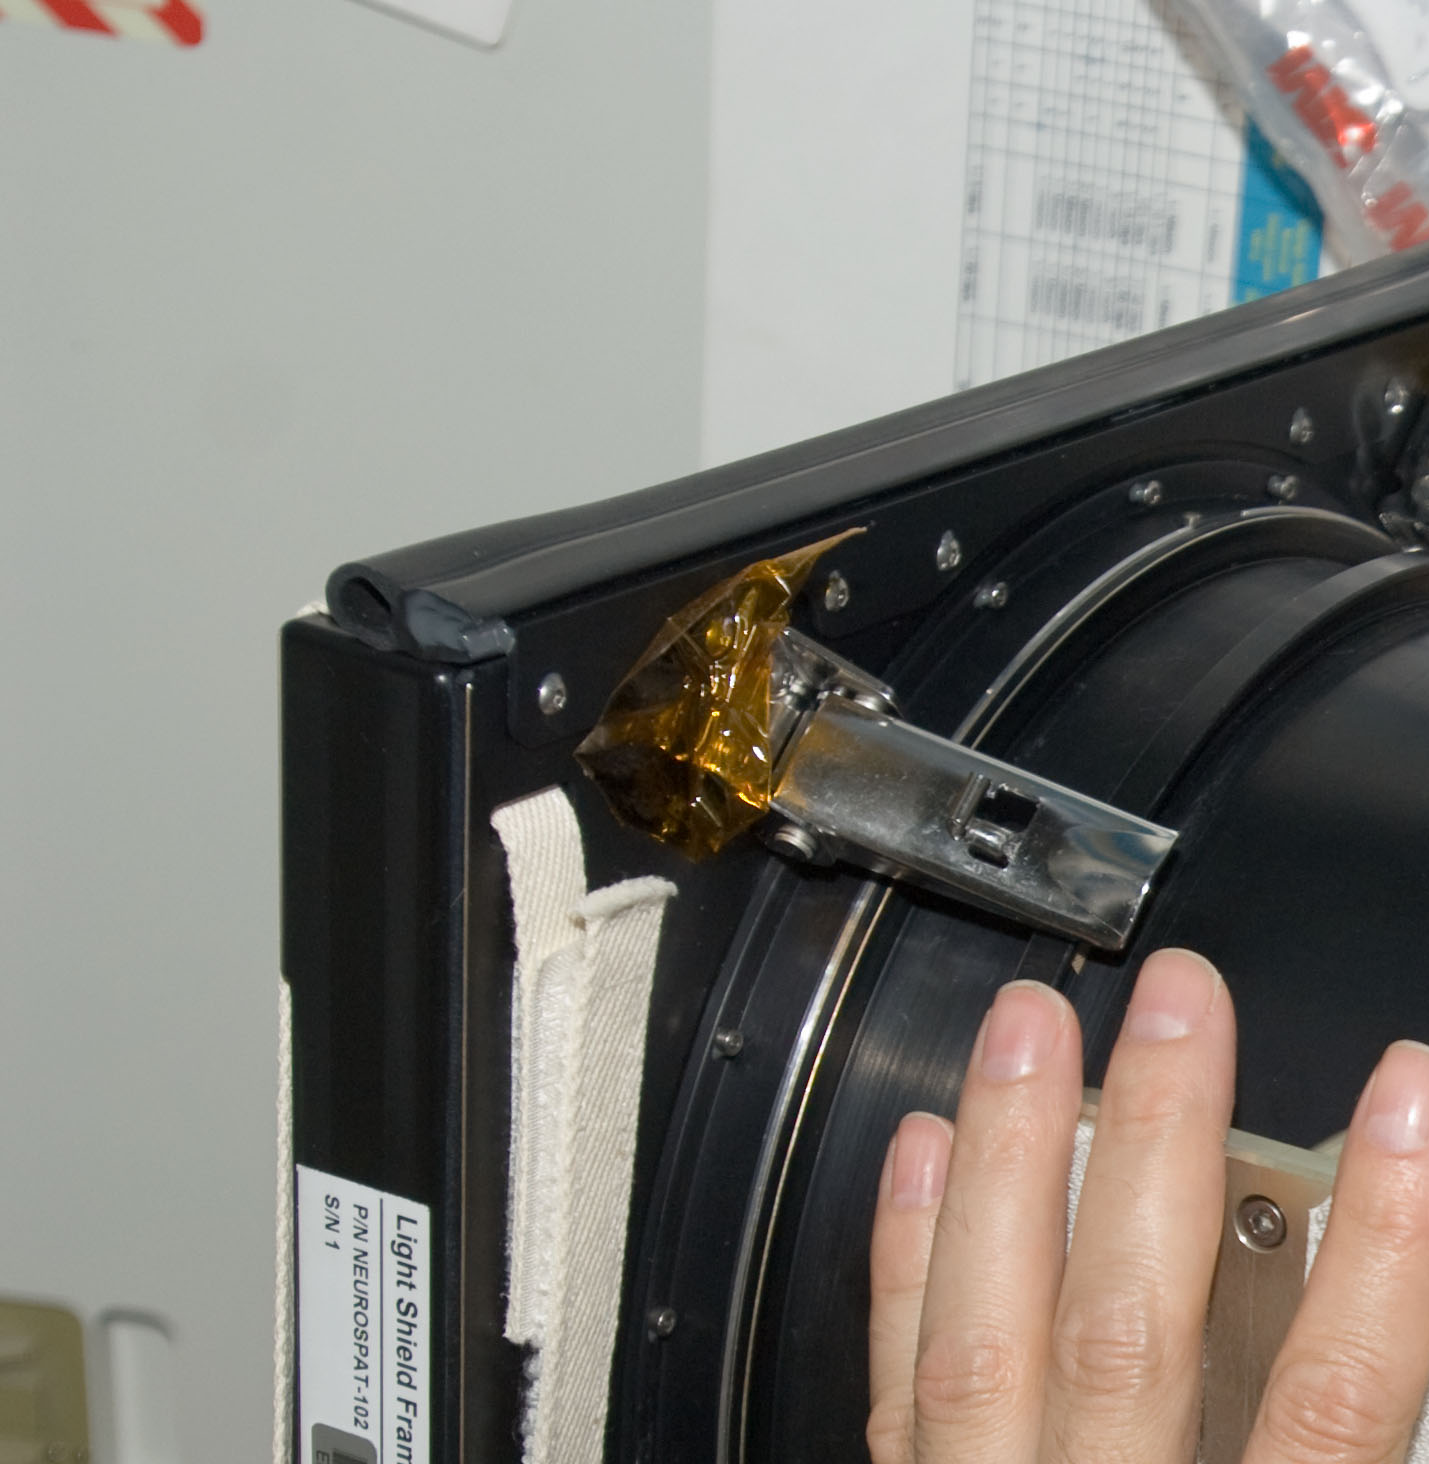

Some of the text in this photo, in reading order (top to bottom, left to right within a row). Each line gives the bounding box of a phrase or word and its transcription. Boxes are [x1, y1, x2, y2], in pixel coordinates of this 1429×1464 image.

[325, 1194, 341, 1250] S/N 1
[391, 1213, 419, 1292] Light
[353, 1203, 370, 1431] P/N NEUROSPAT-102
[396, 1297, 419, 1391] Shield
